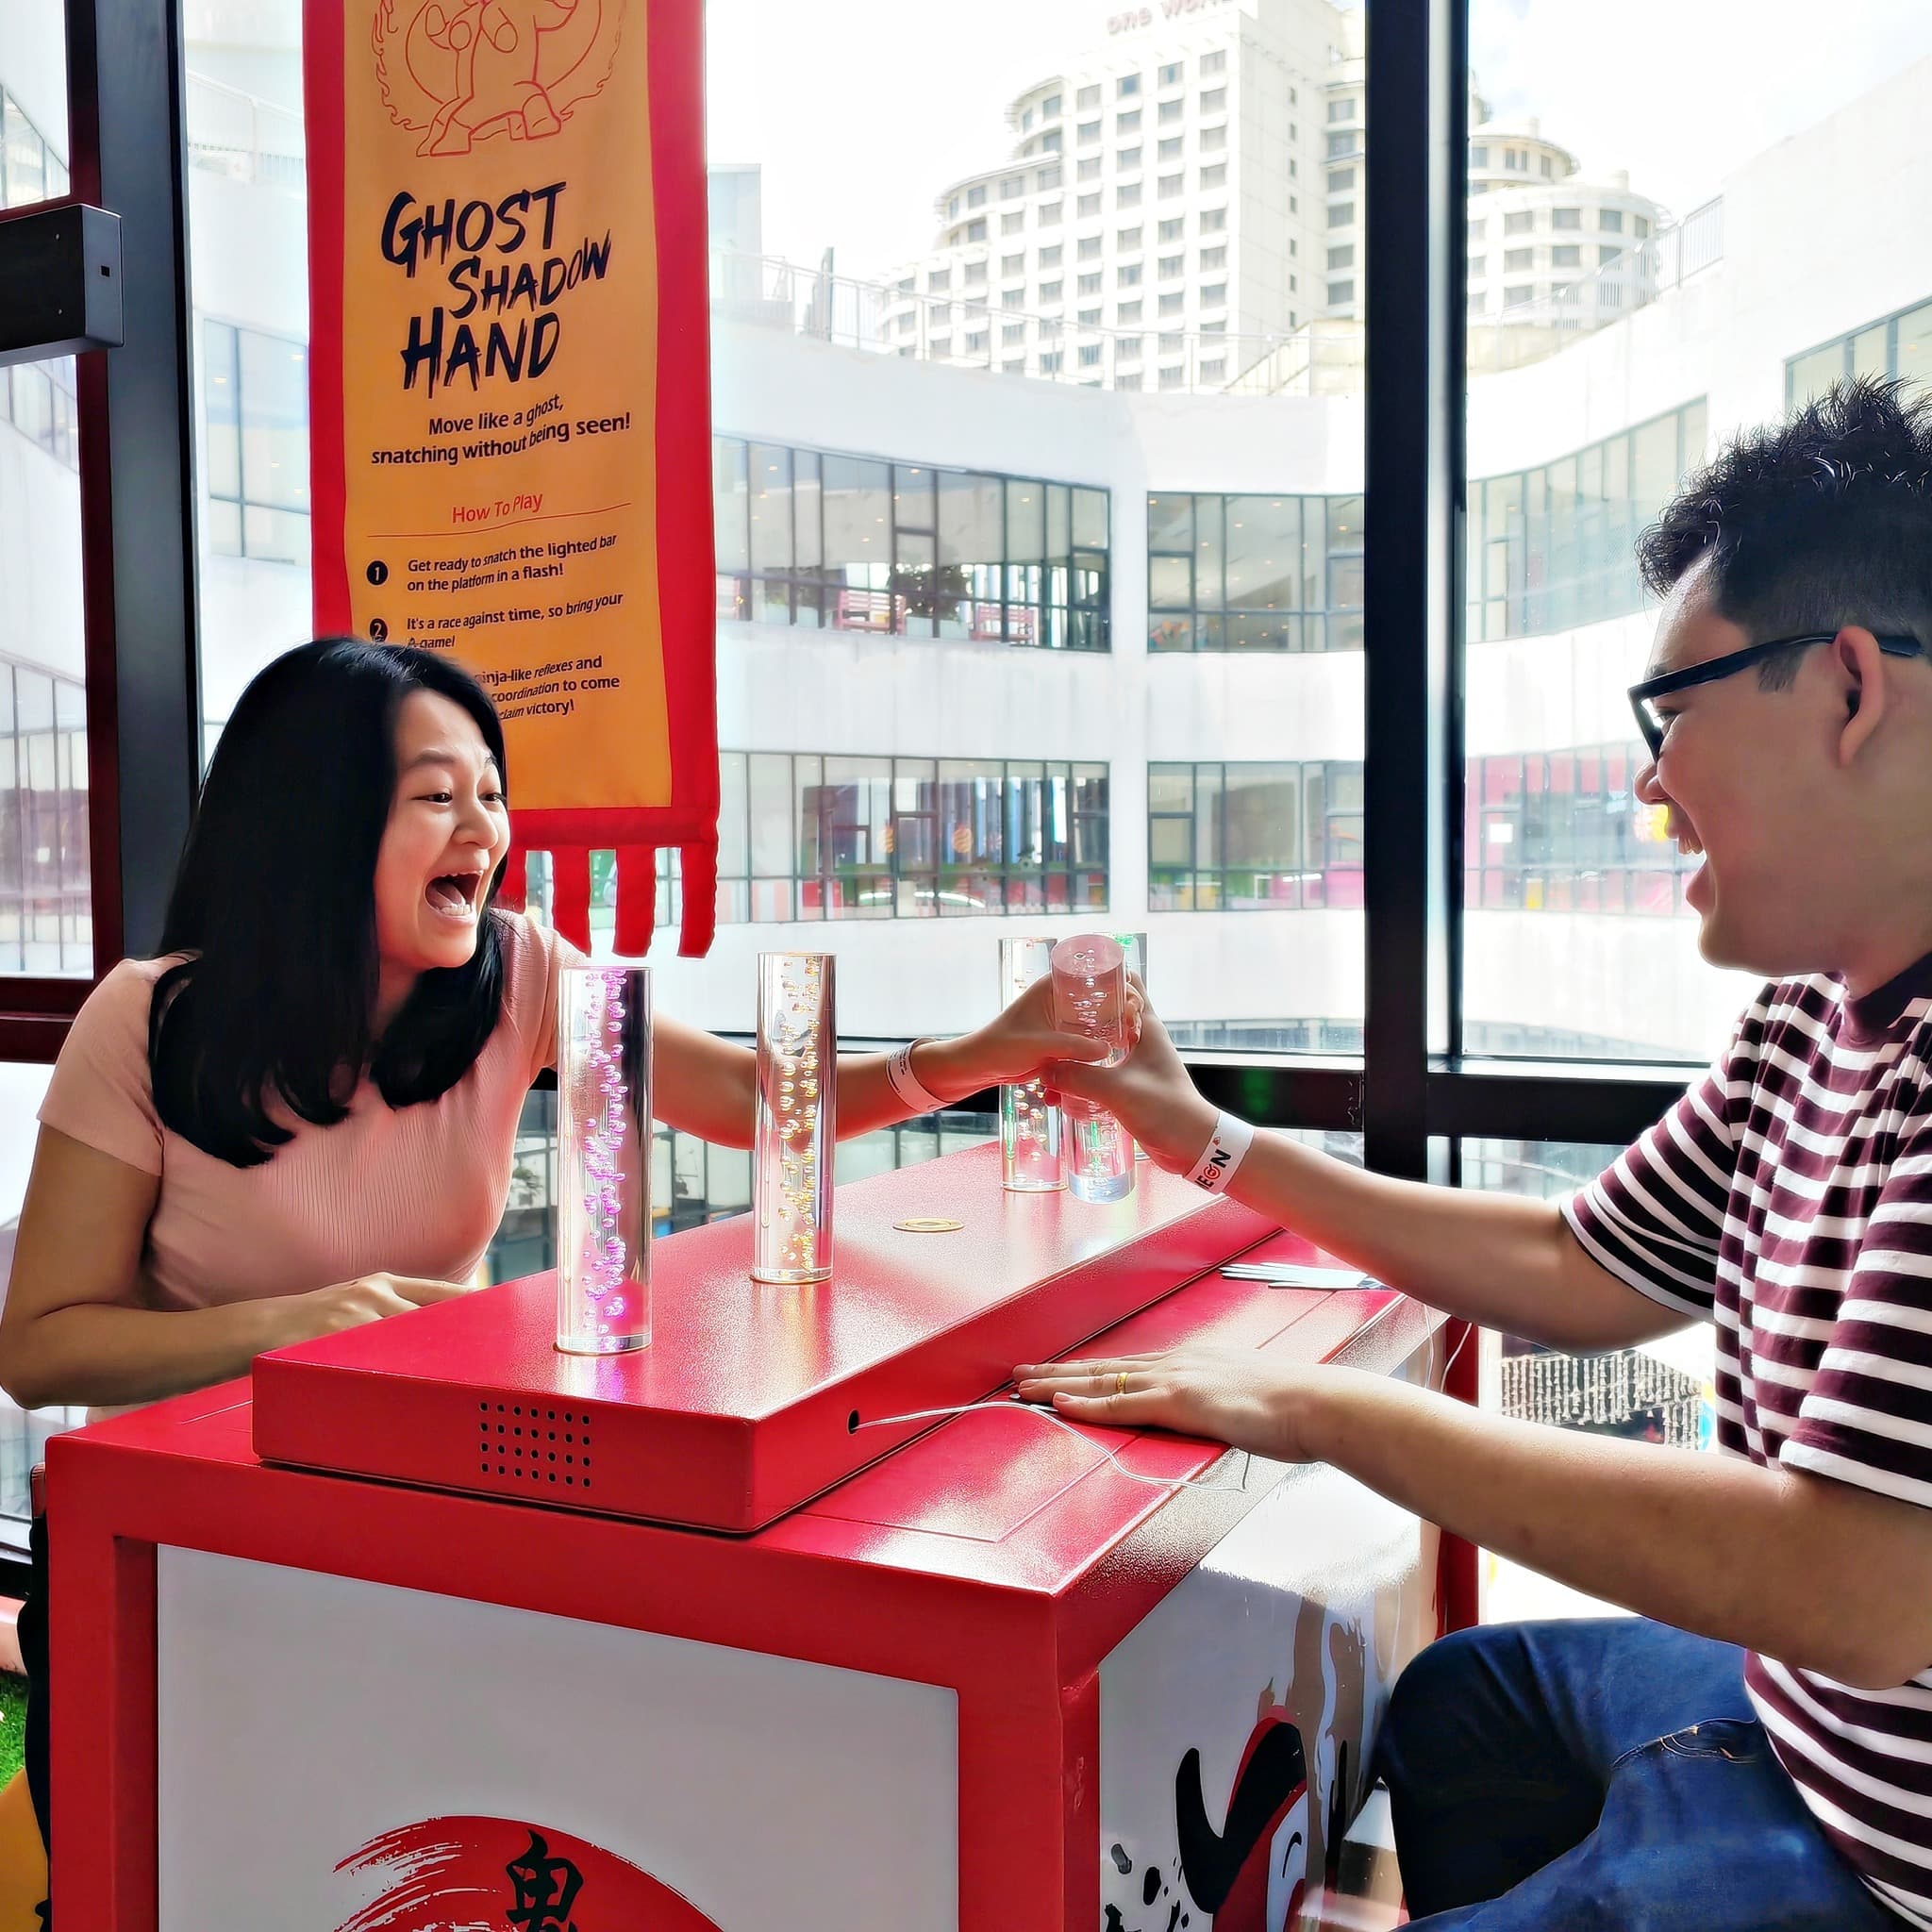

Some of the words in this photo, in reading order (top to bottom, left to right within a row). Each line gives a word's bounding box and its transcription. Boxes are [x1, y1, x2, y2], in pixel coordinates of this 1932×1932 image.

[381, 182, 567, 278] GHOST
[448, 229, 611, 319] SHADOW
[400, 307, 560, 399] HAND
[429, 418, 474, 435] Move
[478, 413, 509, 430] like
[513, 412, 523, 425] a
[526, 393, 564, 426] ghost,
[372, 444, 458, 465] snatching
[463, 435, 527, 458] without
[529, 423, 570, 447] being
[576, 412, 630, 434] seen!
[452, 507, 491, 523] How
[494, 502, 510, 517] To
[512, 493, 543, 513] Play
[408, 559, 431, 572] Get
[434, 558, 469, 573] ready
[471, 557, 481, 568] to
[483, 548, 516, 566] snatch
[520, 545, 543, 558] the
[548, 538, 597, 558] lighted
[599, 535, 617, 548] bar
[408, 581, 424, 591] on
[427, 578, 448, 590] the
[451, 574, 493, 592] platform
[497, 570, 508, 582] in
[511, 570, 520, 580] a
[523, 562, 563, 578] flash!
[408, 618, 425, 630] It's
[427, 620, 435, 629] a
[438, 618, 460, 629] race
[463, 610, 506, 629] against
[508, 608, 544, 623] time,
[548, 607, 563, 617] so
[566, 599, 593, 615] bring
[594, 593, 624, 611] your
[534, 659, 574, 678] reflexes
[575, 655, 603, 670] and
[491, 682, 559, 702] coordination
[563, 679, 576, 691] to
[580, 677, 620, 690] come
[526, 698, 575, 715] victory!
[1194, 1148, 1232, 1190] EON
